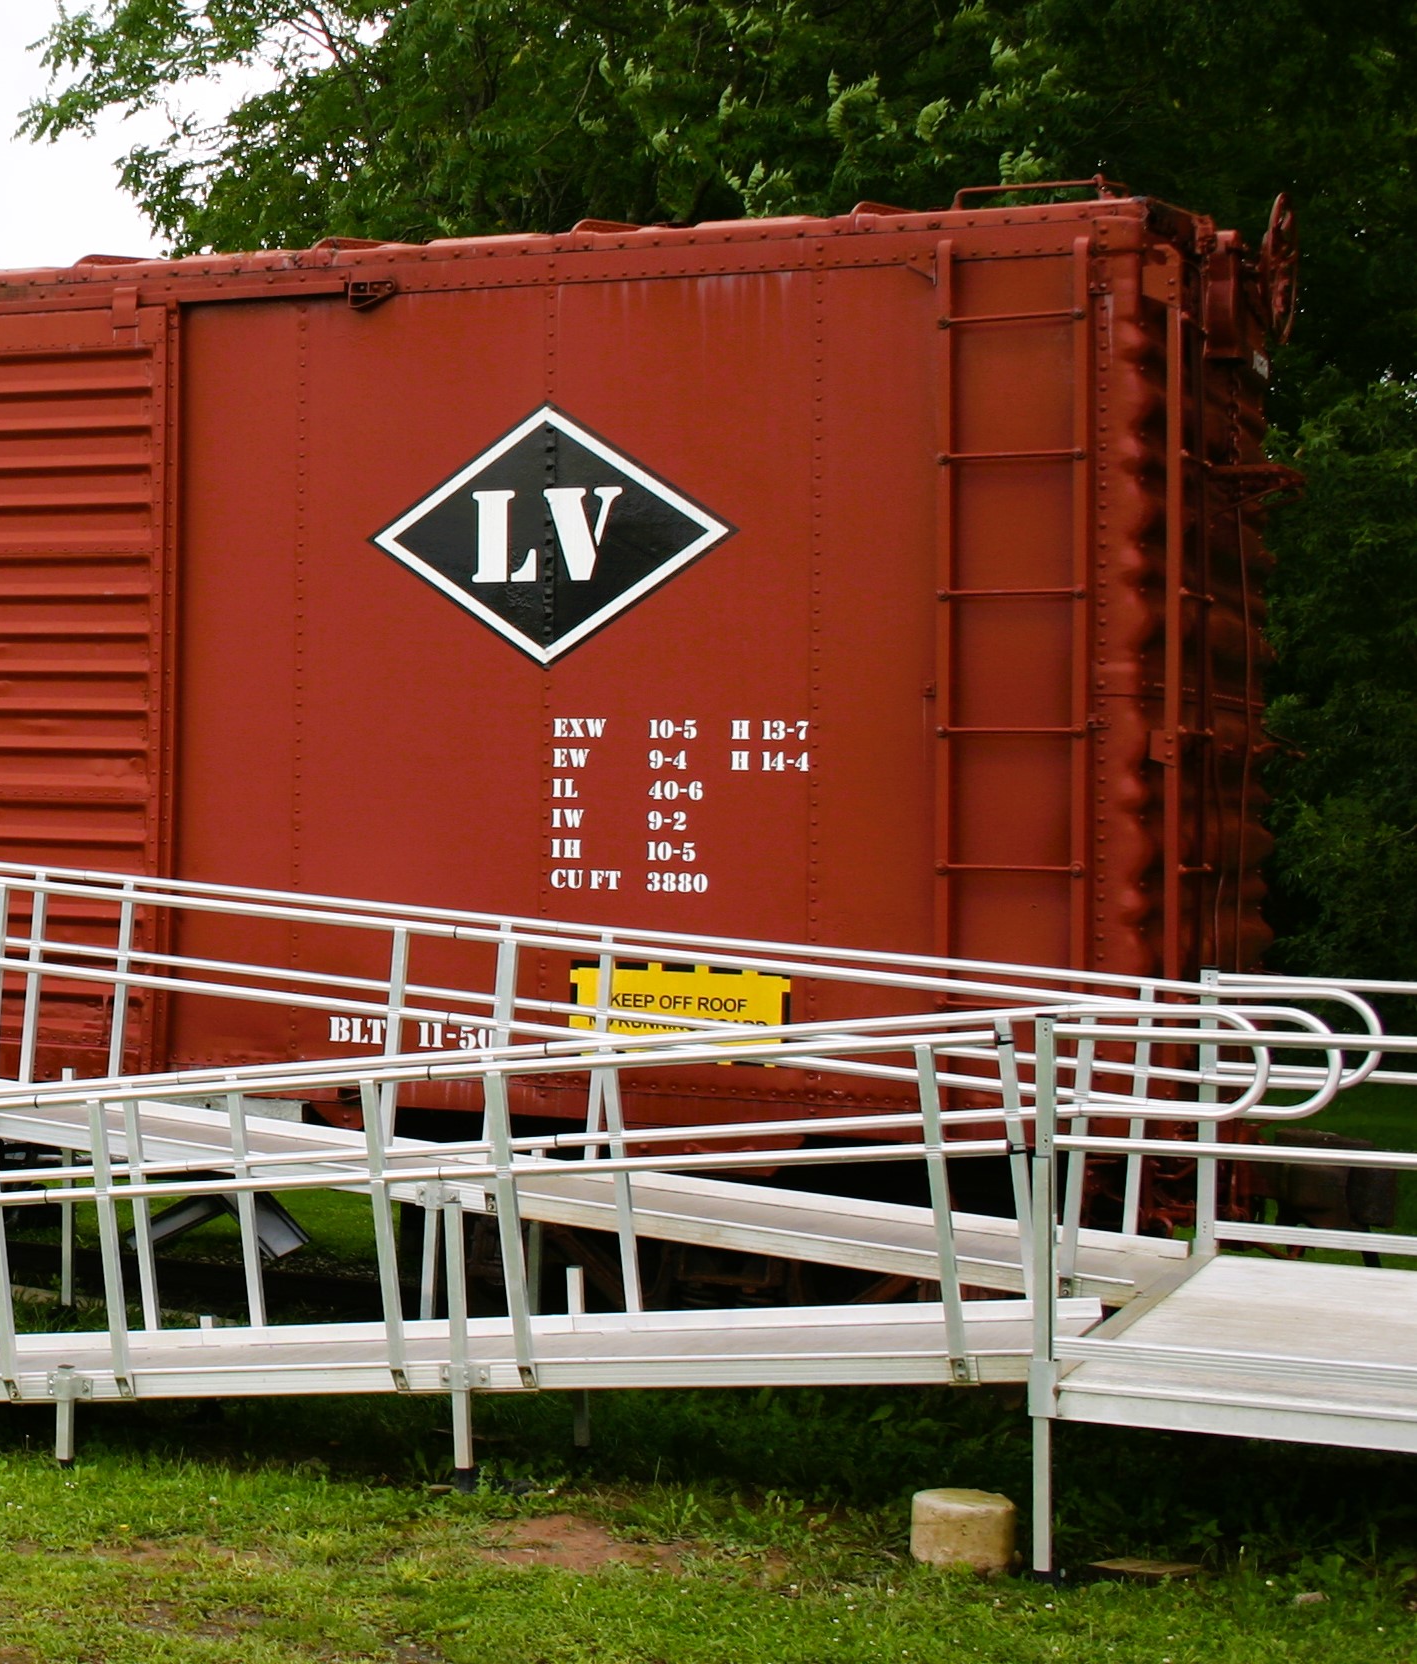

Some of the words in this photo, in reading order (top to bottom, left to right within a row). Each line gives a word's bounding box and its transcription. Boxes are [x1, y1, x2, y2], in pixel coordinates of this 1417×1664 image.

[471, 486, 623, 584] LV
[553, 718, 607, 738] EXW
[649, 719, 698, 740] 10-5
[731, 719, 751, 740] H
[762, 720, 810, 741] 13-7
[553, 748, 590, 768] EW
[648, 749, 687, 770] 9-4
[731, 750, 750, 771] H
[761, 751, 809, 772] 14-4
[552, 778, 578, 798] IL
[648, 780, 704, 801] 40-6
[551, 808, 584, 829] IW
[647, 810, 687, 831] 9-2
[551, 838, 582, 859] IH
[647, 841, 696, 862] 10-5
[550, 868, 583, 889] CU
[589, 869, 621, 891] FT
[646, 871, 709, 893] 3880
[610, 993, 655, 1008] KEEP
[659, 995, 693, 1010] OFF
[697, 997, 748, 1013] ROOF
[329, 1016, 387, 1045] BLT
